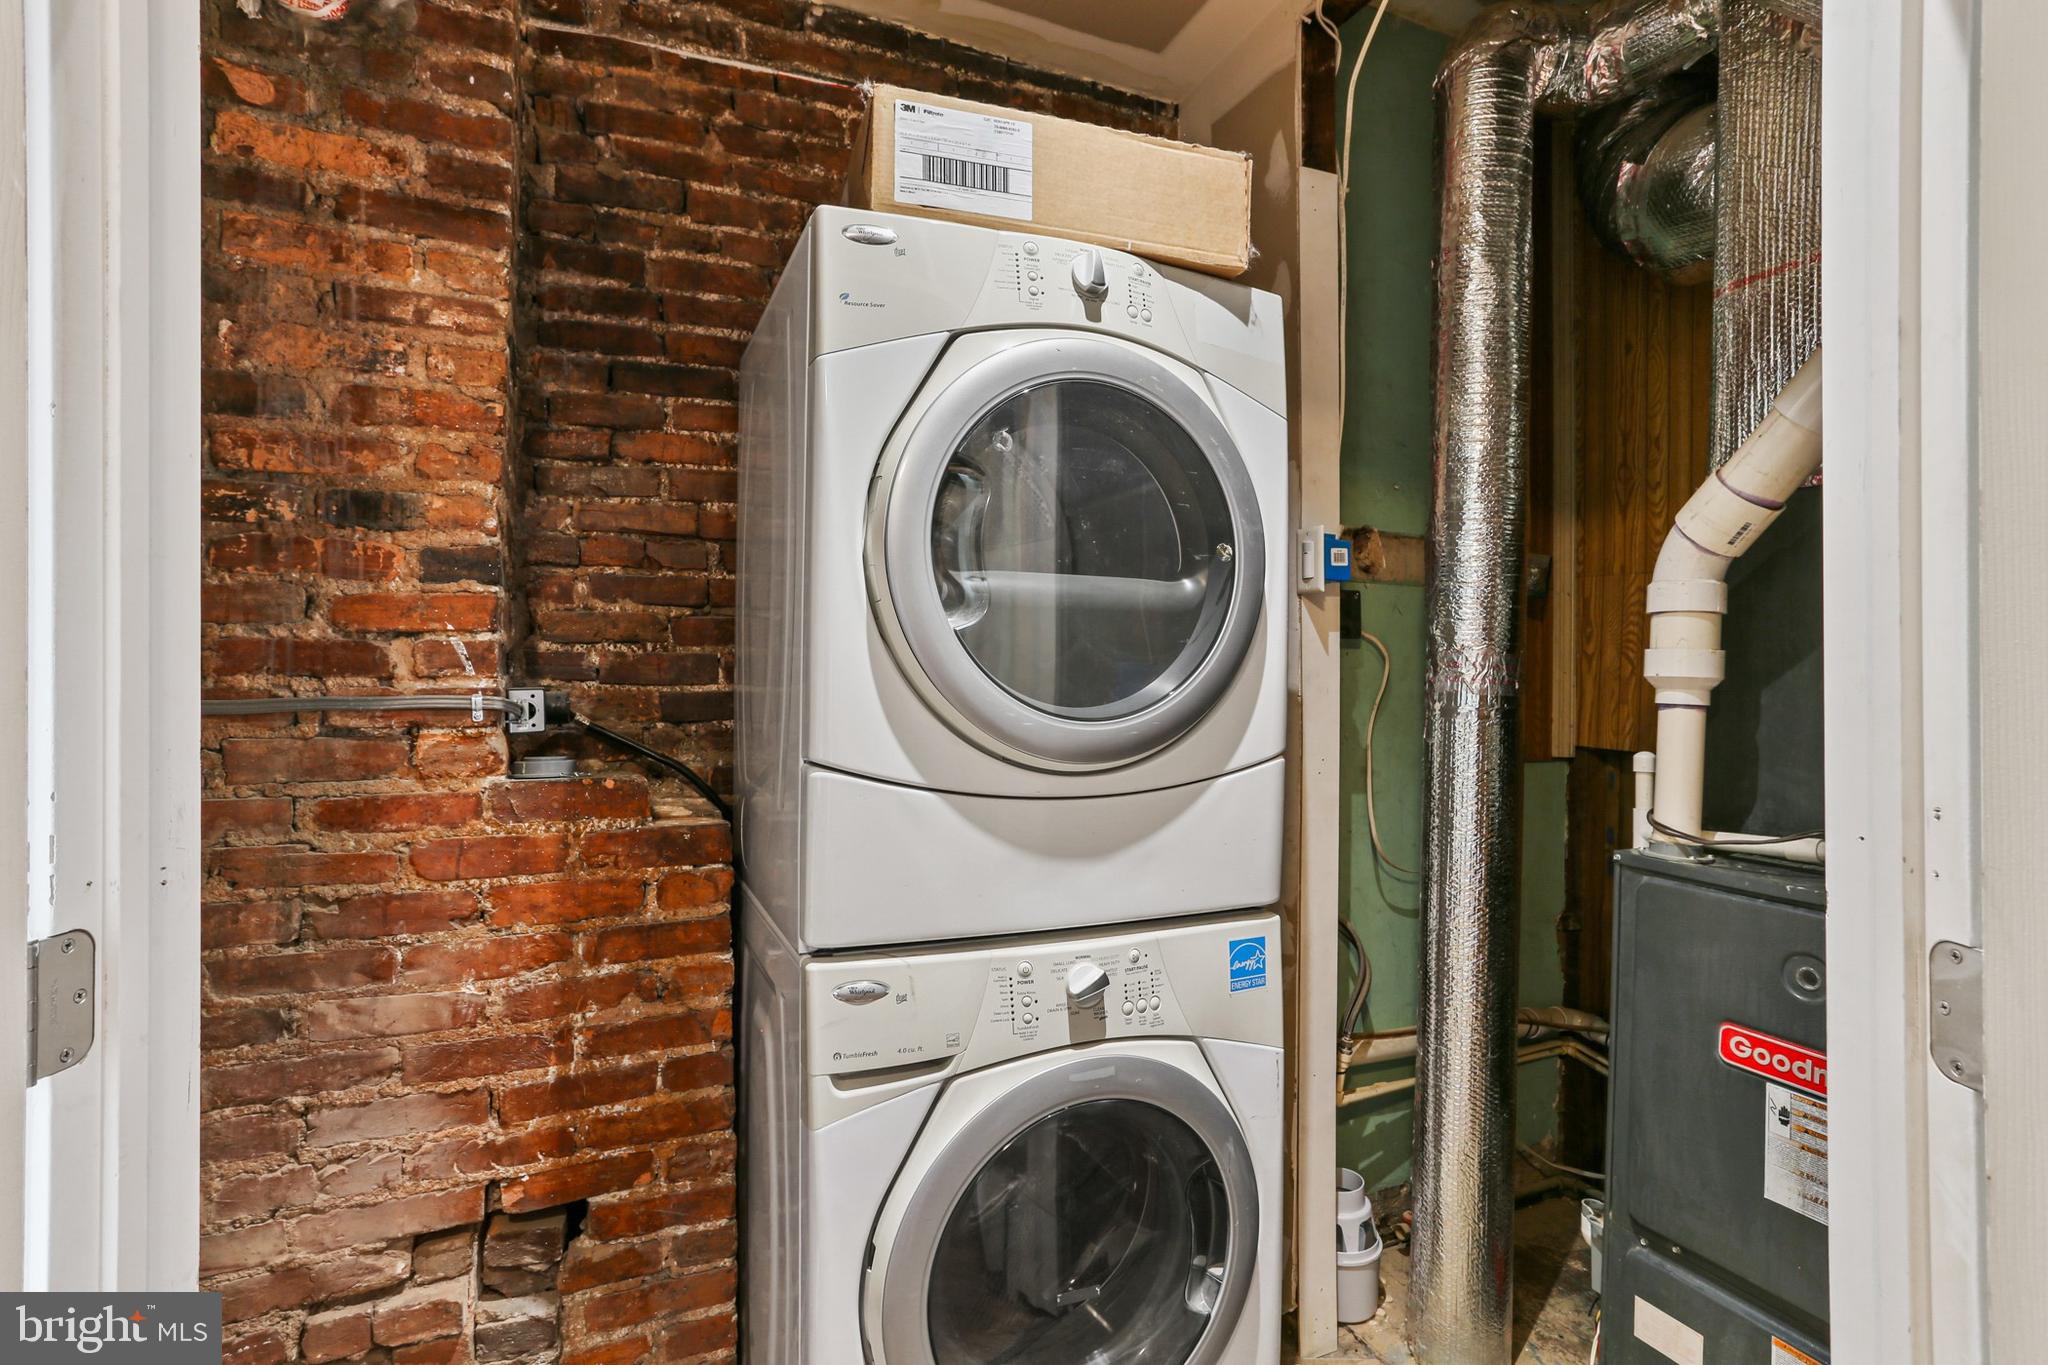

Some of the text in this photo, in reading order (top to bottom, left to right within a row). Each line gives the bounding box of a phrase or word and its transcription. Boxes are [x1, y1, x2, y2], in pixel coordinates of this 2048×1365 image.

[900, 103, 915, 113] 3M
[1232, 977, 1266, 991] ENERGY STAR
[842, 1051, 878, 1060] TumbleFresh
